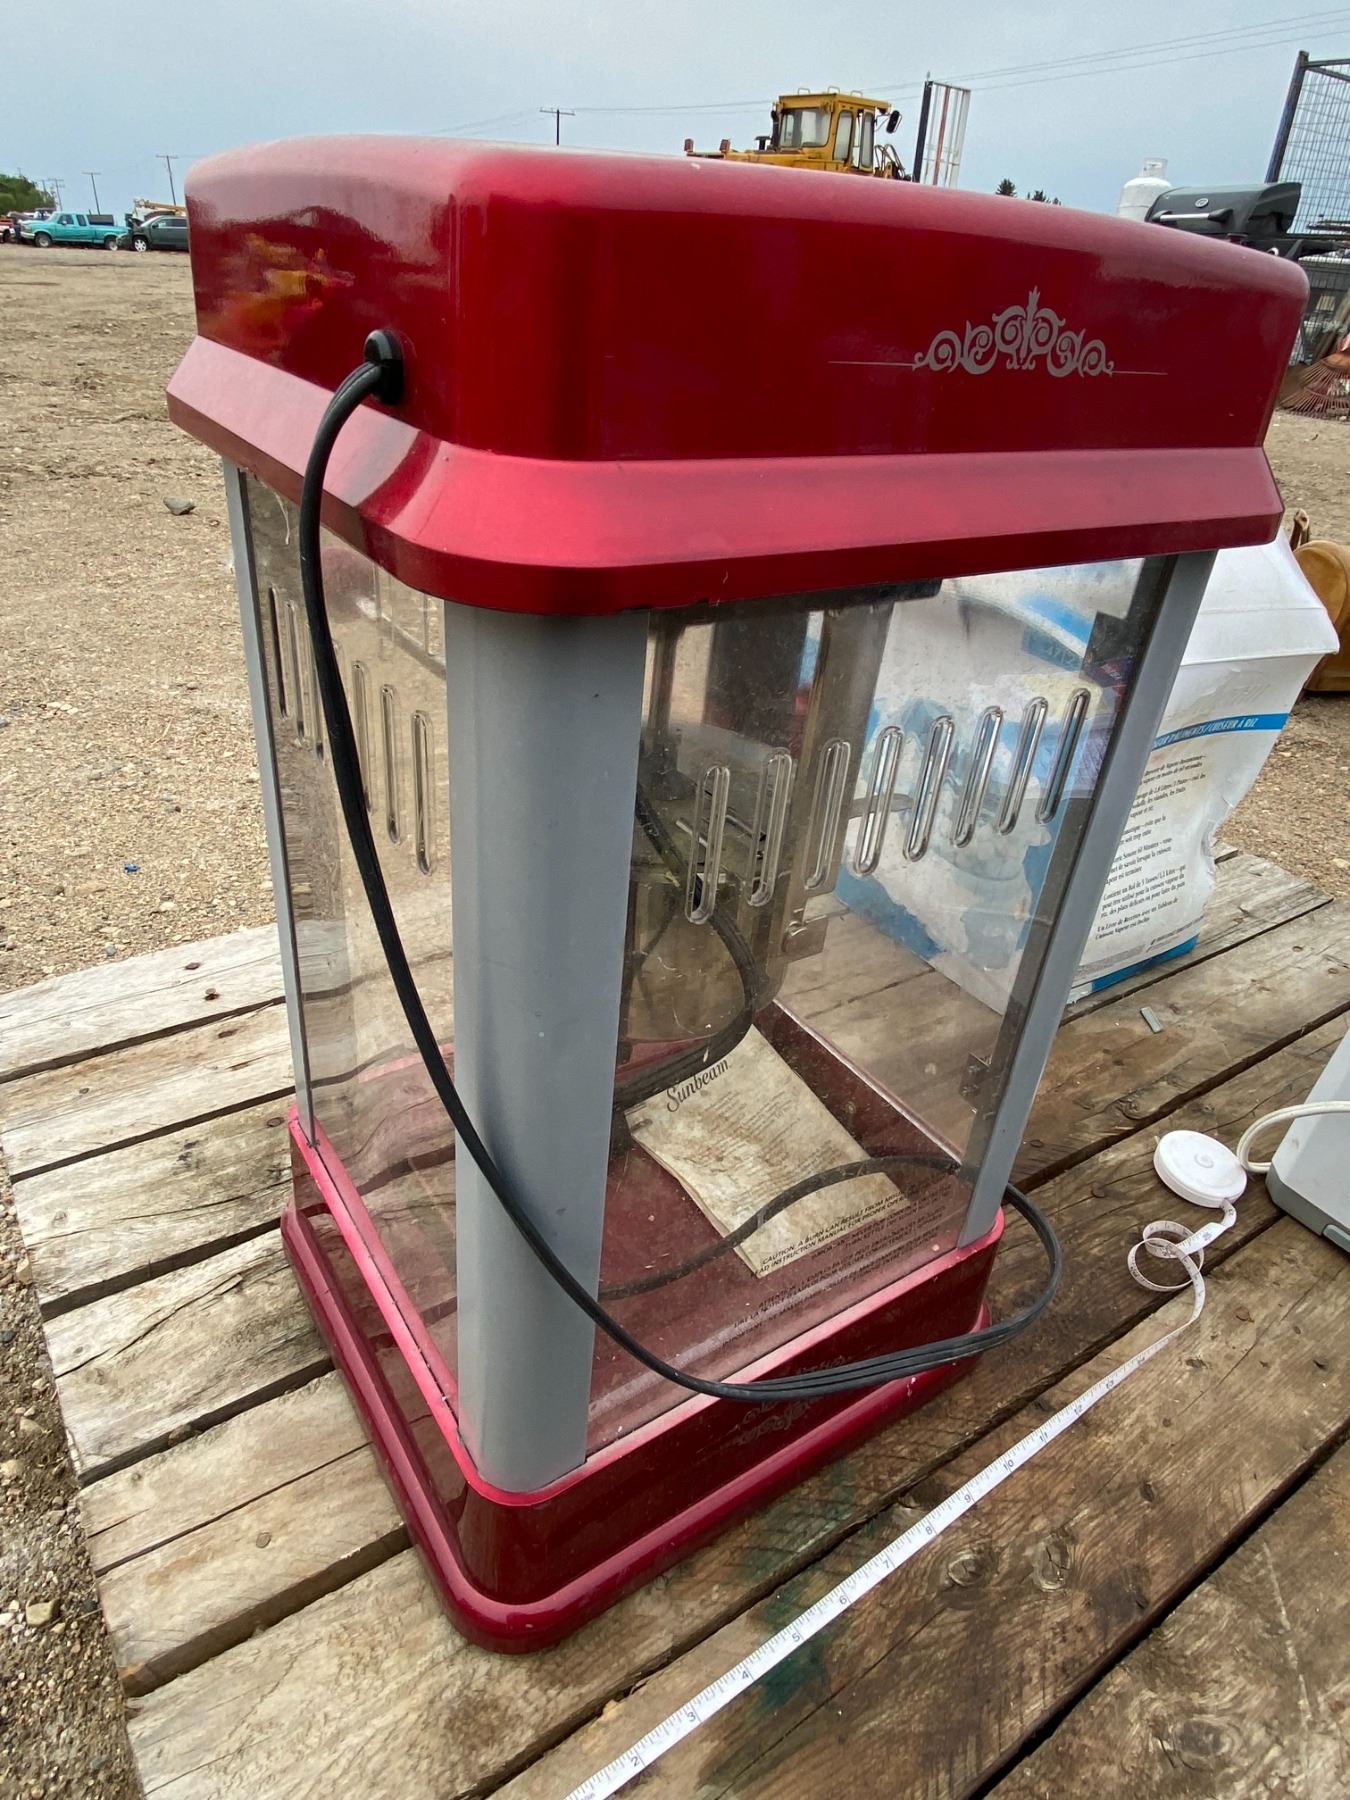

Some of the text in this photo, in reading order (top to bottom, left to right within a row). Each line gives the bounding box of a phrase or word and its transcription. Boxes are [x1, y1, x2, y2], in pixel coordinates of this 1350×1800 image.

[666, 1059, 728, 1113] Sunbeam
[825, 1222, 840, 1233] CAN
[864, 1199, 884, 1212] FROM
[771, 1241, 816, 1267] INSTRUCTION
[817, 1225, 846, 1242] MANUAL
[1074, 1404, 1084, 1416] 12
[1002, 1459, 1015, 1473] 10
[964, 1493, 972, 1505] 9
[925, 1525, 933, 1537] 8
[882, 1560, 891, 1571] 7
[839, 1595, 848, 1606] 6
[791, 1632, 802, 1643] 5
[741, 1670, 750, 1680] 4
[686, 1711, 697, 1723] 3
[630, 1756, 641, 1768] 2
